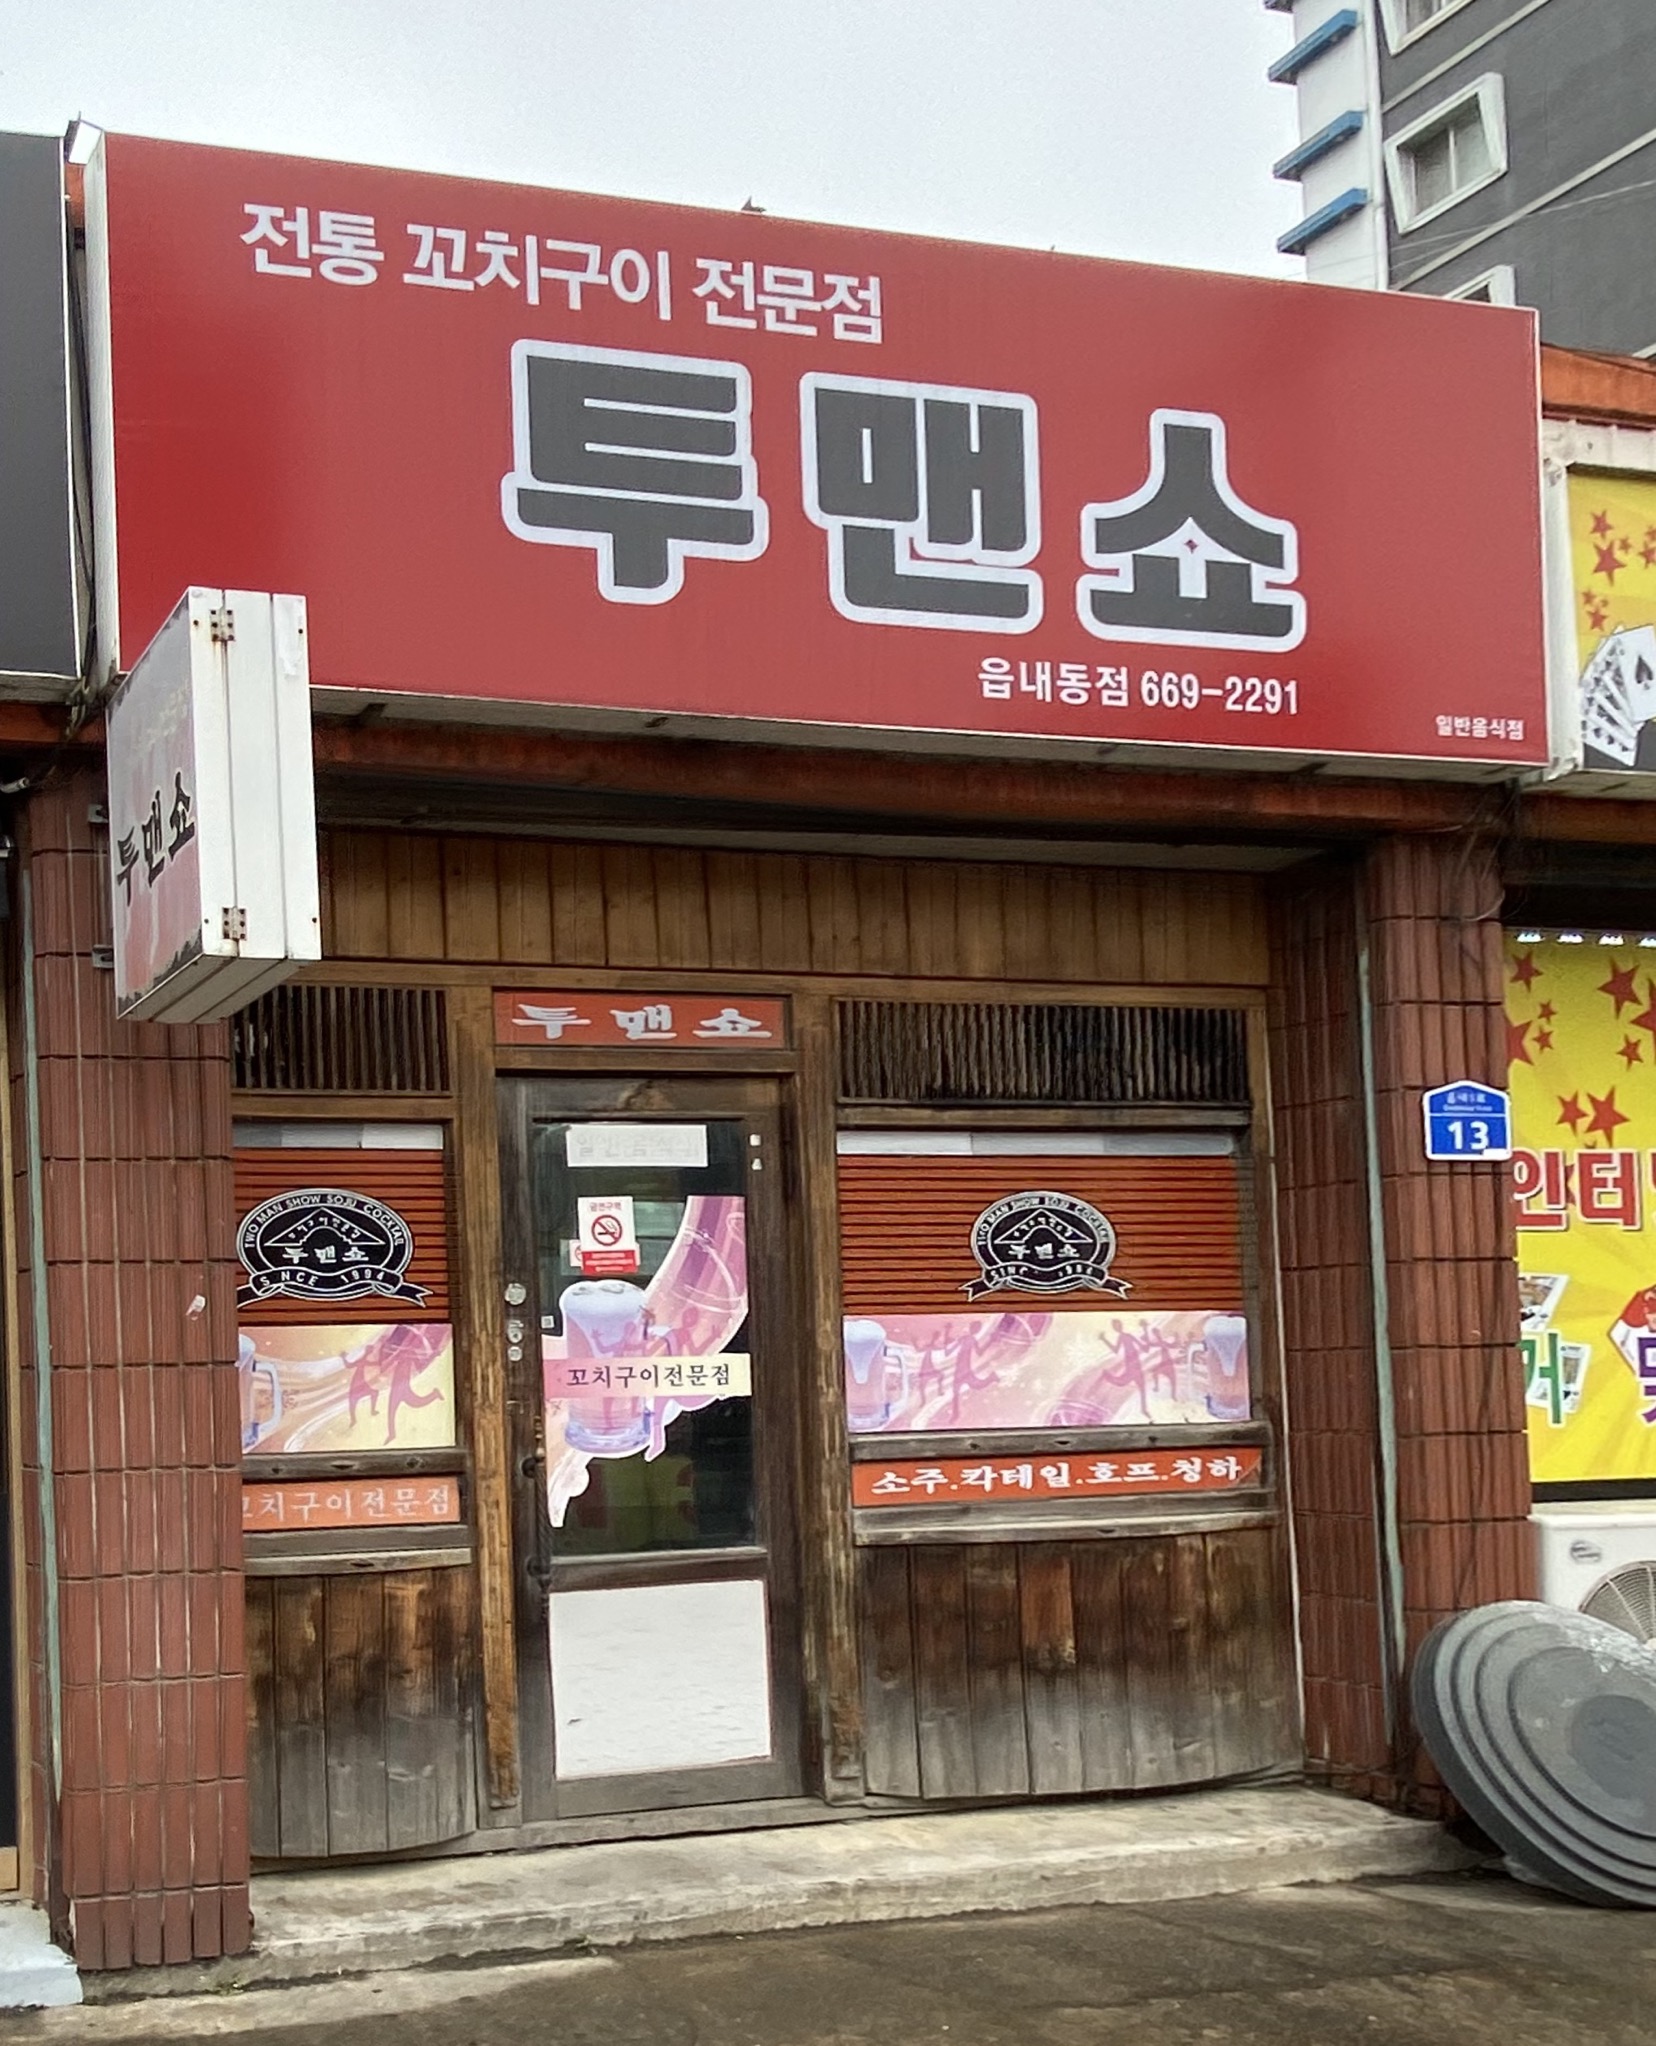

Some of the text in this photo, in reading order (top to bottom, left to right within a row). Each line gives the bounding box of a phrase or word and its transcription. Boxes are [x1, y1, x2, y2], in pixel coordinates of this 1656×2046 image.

[240, 203, 884, 344] 전통 꼬치구이 전문점
[501, 338, 1307, 652] 투맨쇼
[977, 657, 1298, 716] 읍내동점 669-2291
[1436, 714, 1524, 741] 일반음식점
[116, 770, 195, 907] 투맨쇼
[1447, 1120, 1489, 1150] 13
[244, 1224, 259, 1248] TWO
[256, 1203, 284, 1224] MAN
[286, 1194, 322, 1210] SHOW
[566, 1363, 730, 1389] 꼬치구이전문점
